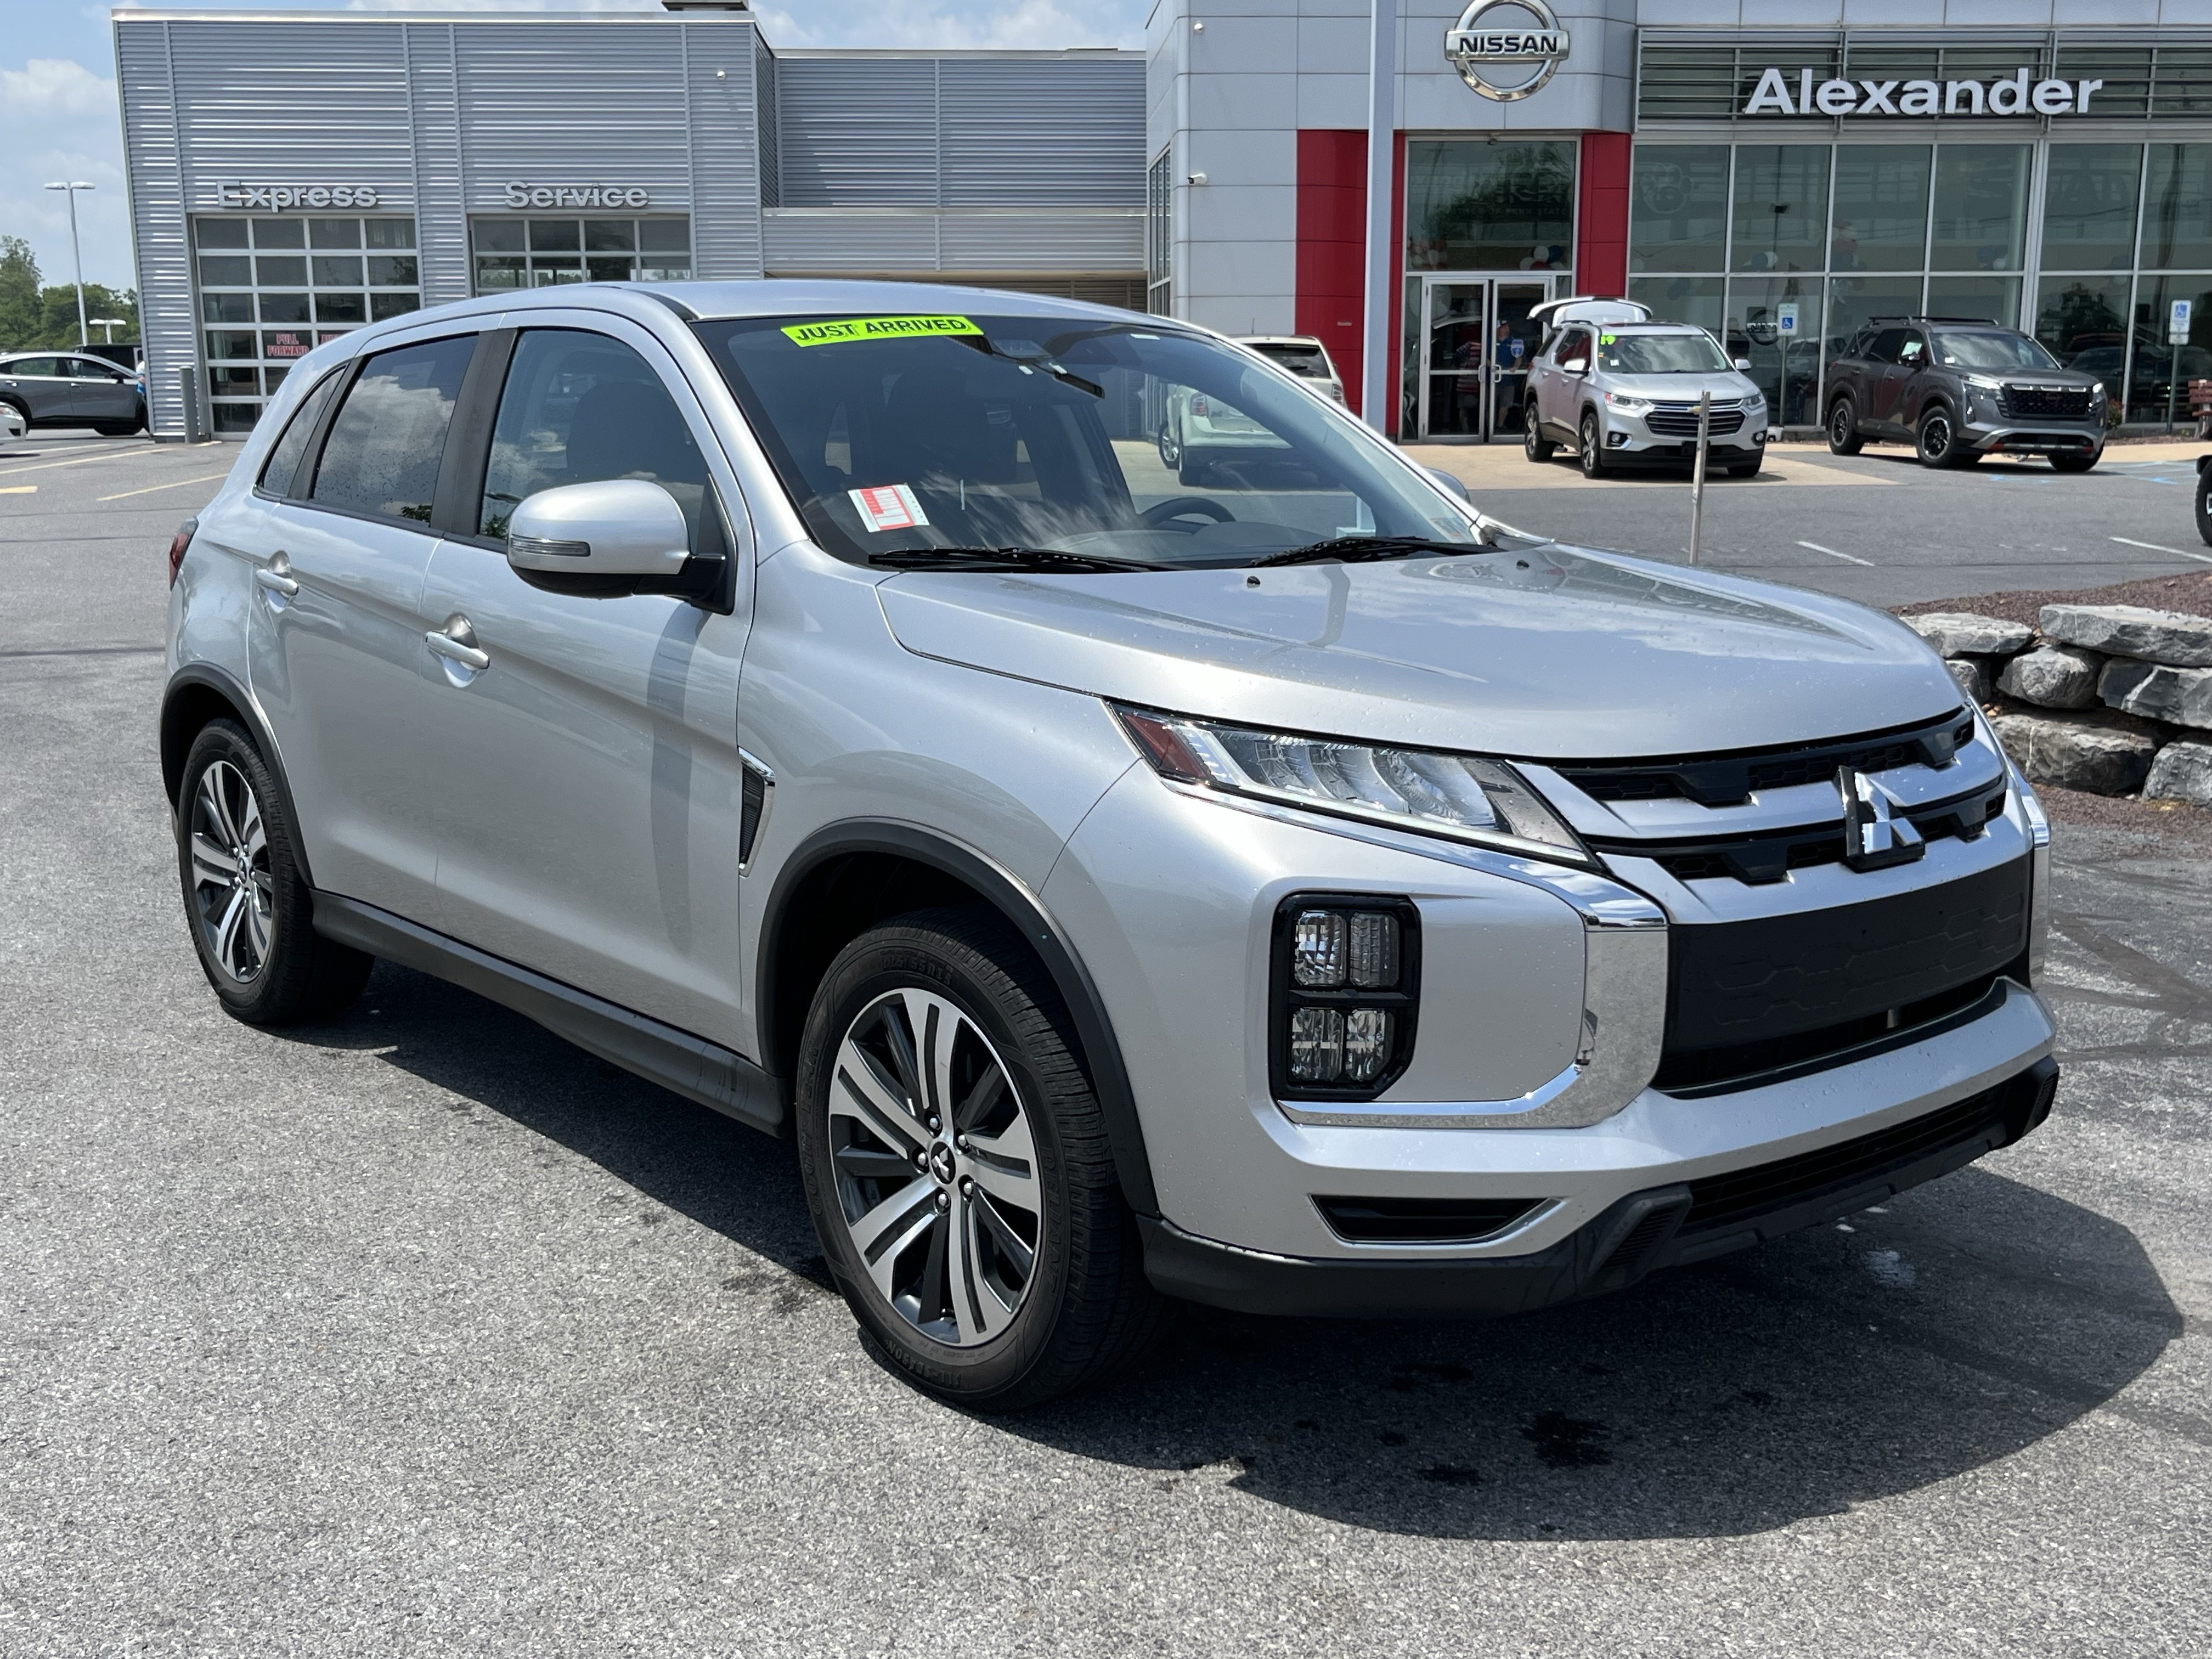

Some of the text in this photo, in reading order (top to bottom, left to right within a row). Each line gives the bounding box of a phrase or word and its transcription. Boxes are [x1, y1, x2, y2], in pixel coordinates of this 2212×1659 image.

[1459, 35, 1558, 53] NISSAN
[1743, 67, 2103, 115] Alexander
[217, 180, 377, 213] Express
[505, 181, 650, 208] Service
[276, 334, 299, 345] PULL
[795, 318, 971, 342] JUST ARRIVED
[267, 345, 310, 357] FORWARD
